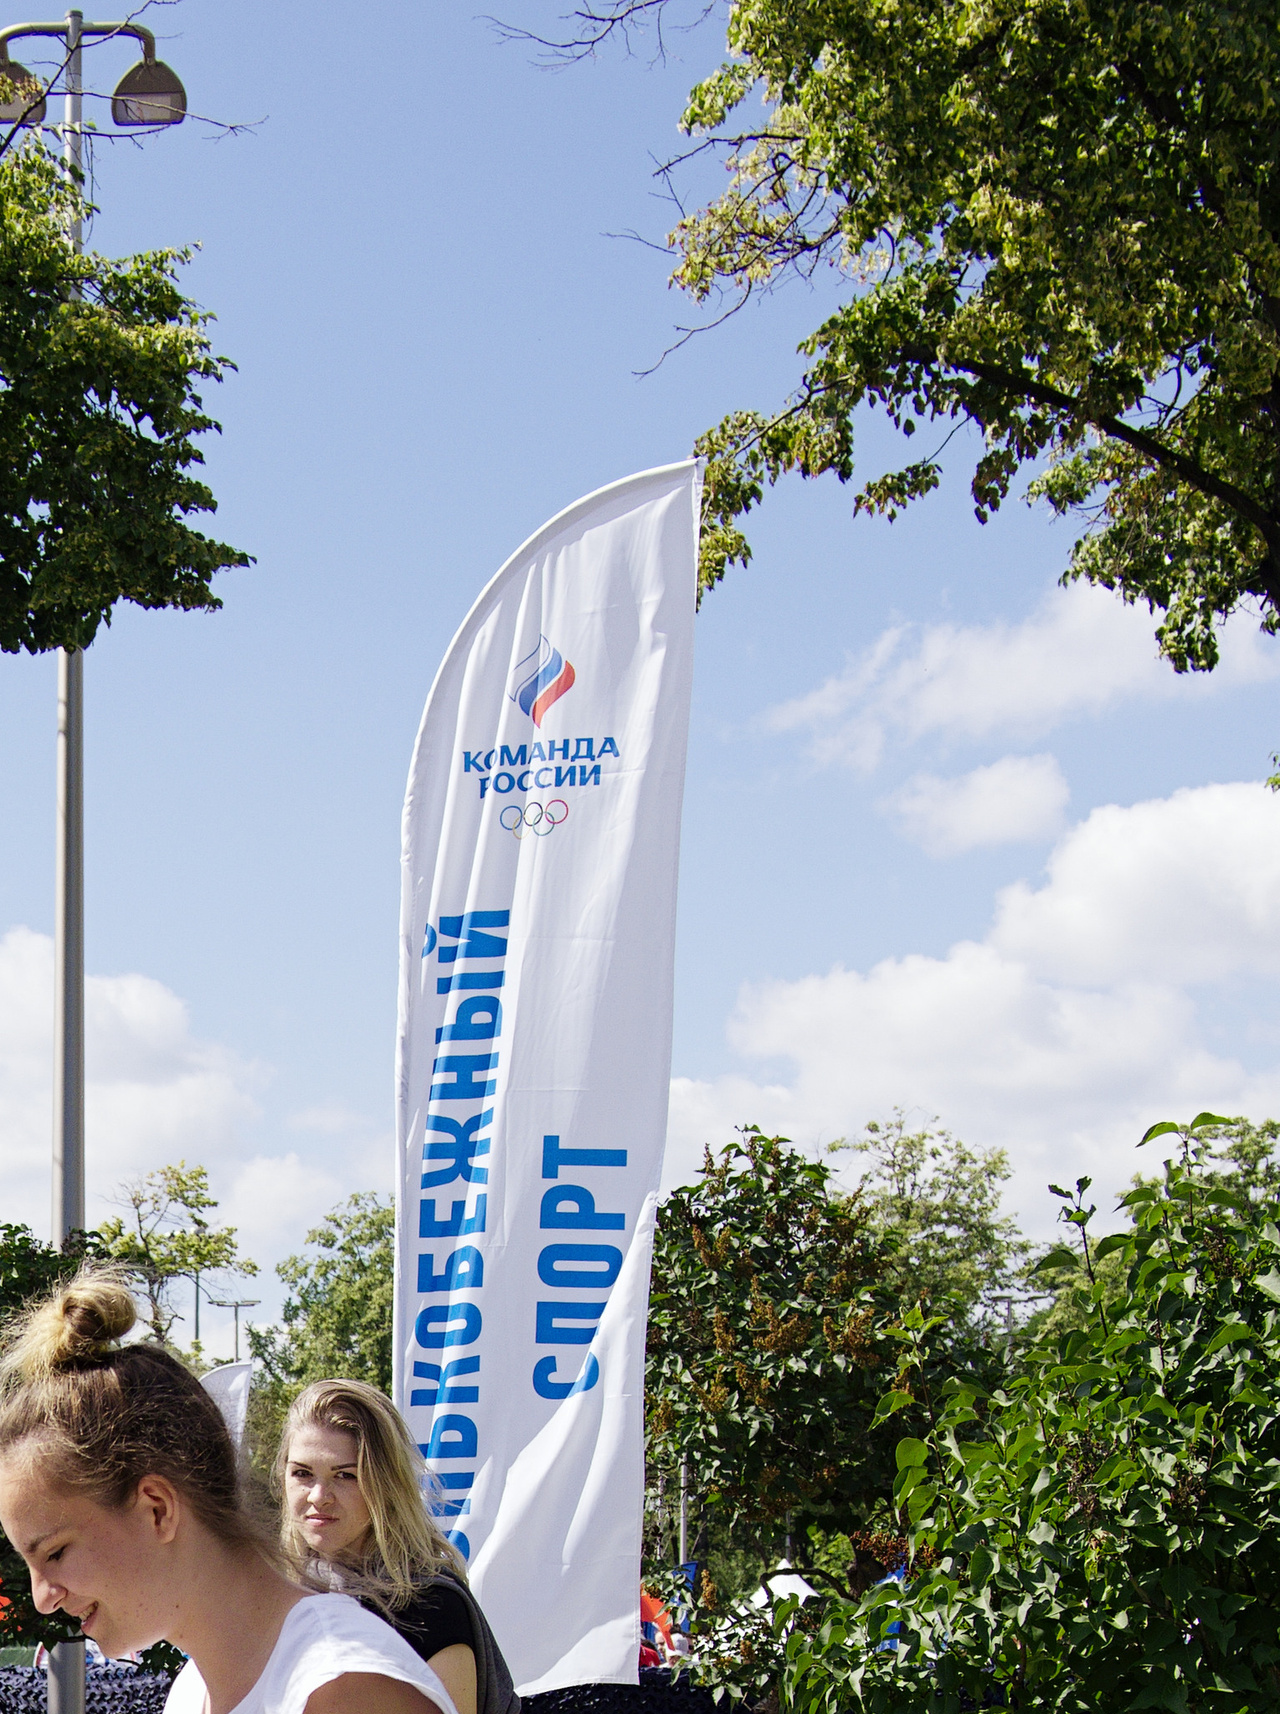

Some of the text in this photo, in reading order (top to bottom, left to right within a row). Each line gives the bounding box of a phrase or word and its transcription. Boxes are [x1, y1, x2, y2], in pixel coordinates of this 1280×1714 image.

[462, 736, 620, 773] КОМАНДА
[478, 764, 601, 799] РОССИИ
[533, 1134, 628, 1400] СПОРТ
